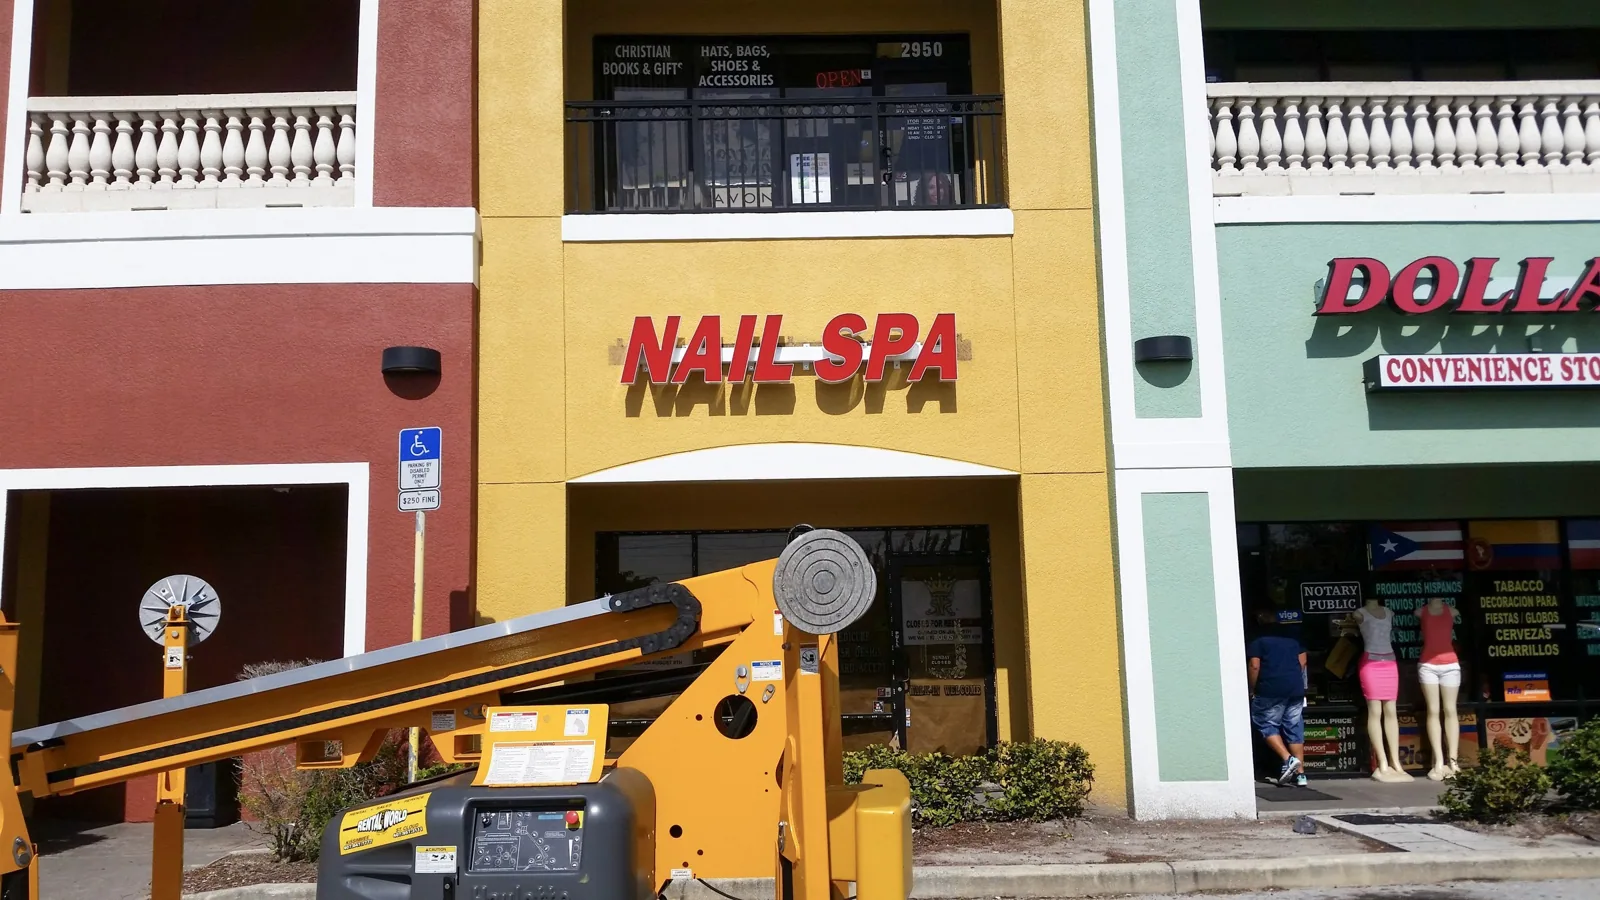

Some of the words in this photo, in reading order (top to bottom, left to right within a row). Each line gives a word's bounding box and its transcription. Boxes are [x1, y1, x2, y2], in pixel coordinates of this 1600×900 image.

[615, 45, 671, 58] CHRISTIAN
[701, 45, 733, 59] HATS,
[736, 45, 771, 59] BAGS,
[901, 42, 943, 58] 2950
[603, 62, 640, 75] BOOKS
[642, 62, 651, 75] &
[711, 60, 748, 72] SHOES
[751, 60, 761, 71] &
[698, 74, 774, 87] ACCESSORIES
[816, 69, 862, 90] OPEN
[714, 192, 773, 204] AVON
[1312, 255, 1600, 316] DOLLA
[620, 313, 795, 384] NAIL
[813, 313, 958, 384] SPA
[1386, 356, 1554, 384] CONVENIENCE
[1559, 356, 1600, 383] STO
[1303, 585, 1358, 597] NOTARY
[1376, 582, 1422, 595] PRODUCTOS
[1423, 581, 1462, 594] HISPANOS
[1493, 580, 1544, 592] TABACCO
[1308, 598, 1356, 610] PUBLIC
[1384, 598, 1414, 611] ENVIOS
[1480, 596, 1534, 608] DECORACION
[1535, 595, 1558, 607] PARA
[1278, 610, 1298, 620] vigo
[1393, 614, 1420, 627] NVIOS
[1485, 612, 1519, 624] FIESTAS
[1525, 611, 1560, 624] GLOBOS
[1398, 630, 1416, 643] SUR
[1495, 628, 1552, 641] CERVEZAS
[1488, 643, 1560, 657] CIGARRILLOS
[943, 684, 982, 696] WELCOME
[1303, 729, 1328, 737] ewport
[1303, 744, 1326, 752] ewport
[357, 811, 383, 832] RENTAL
[383, 808, 408, 829] WORLD
